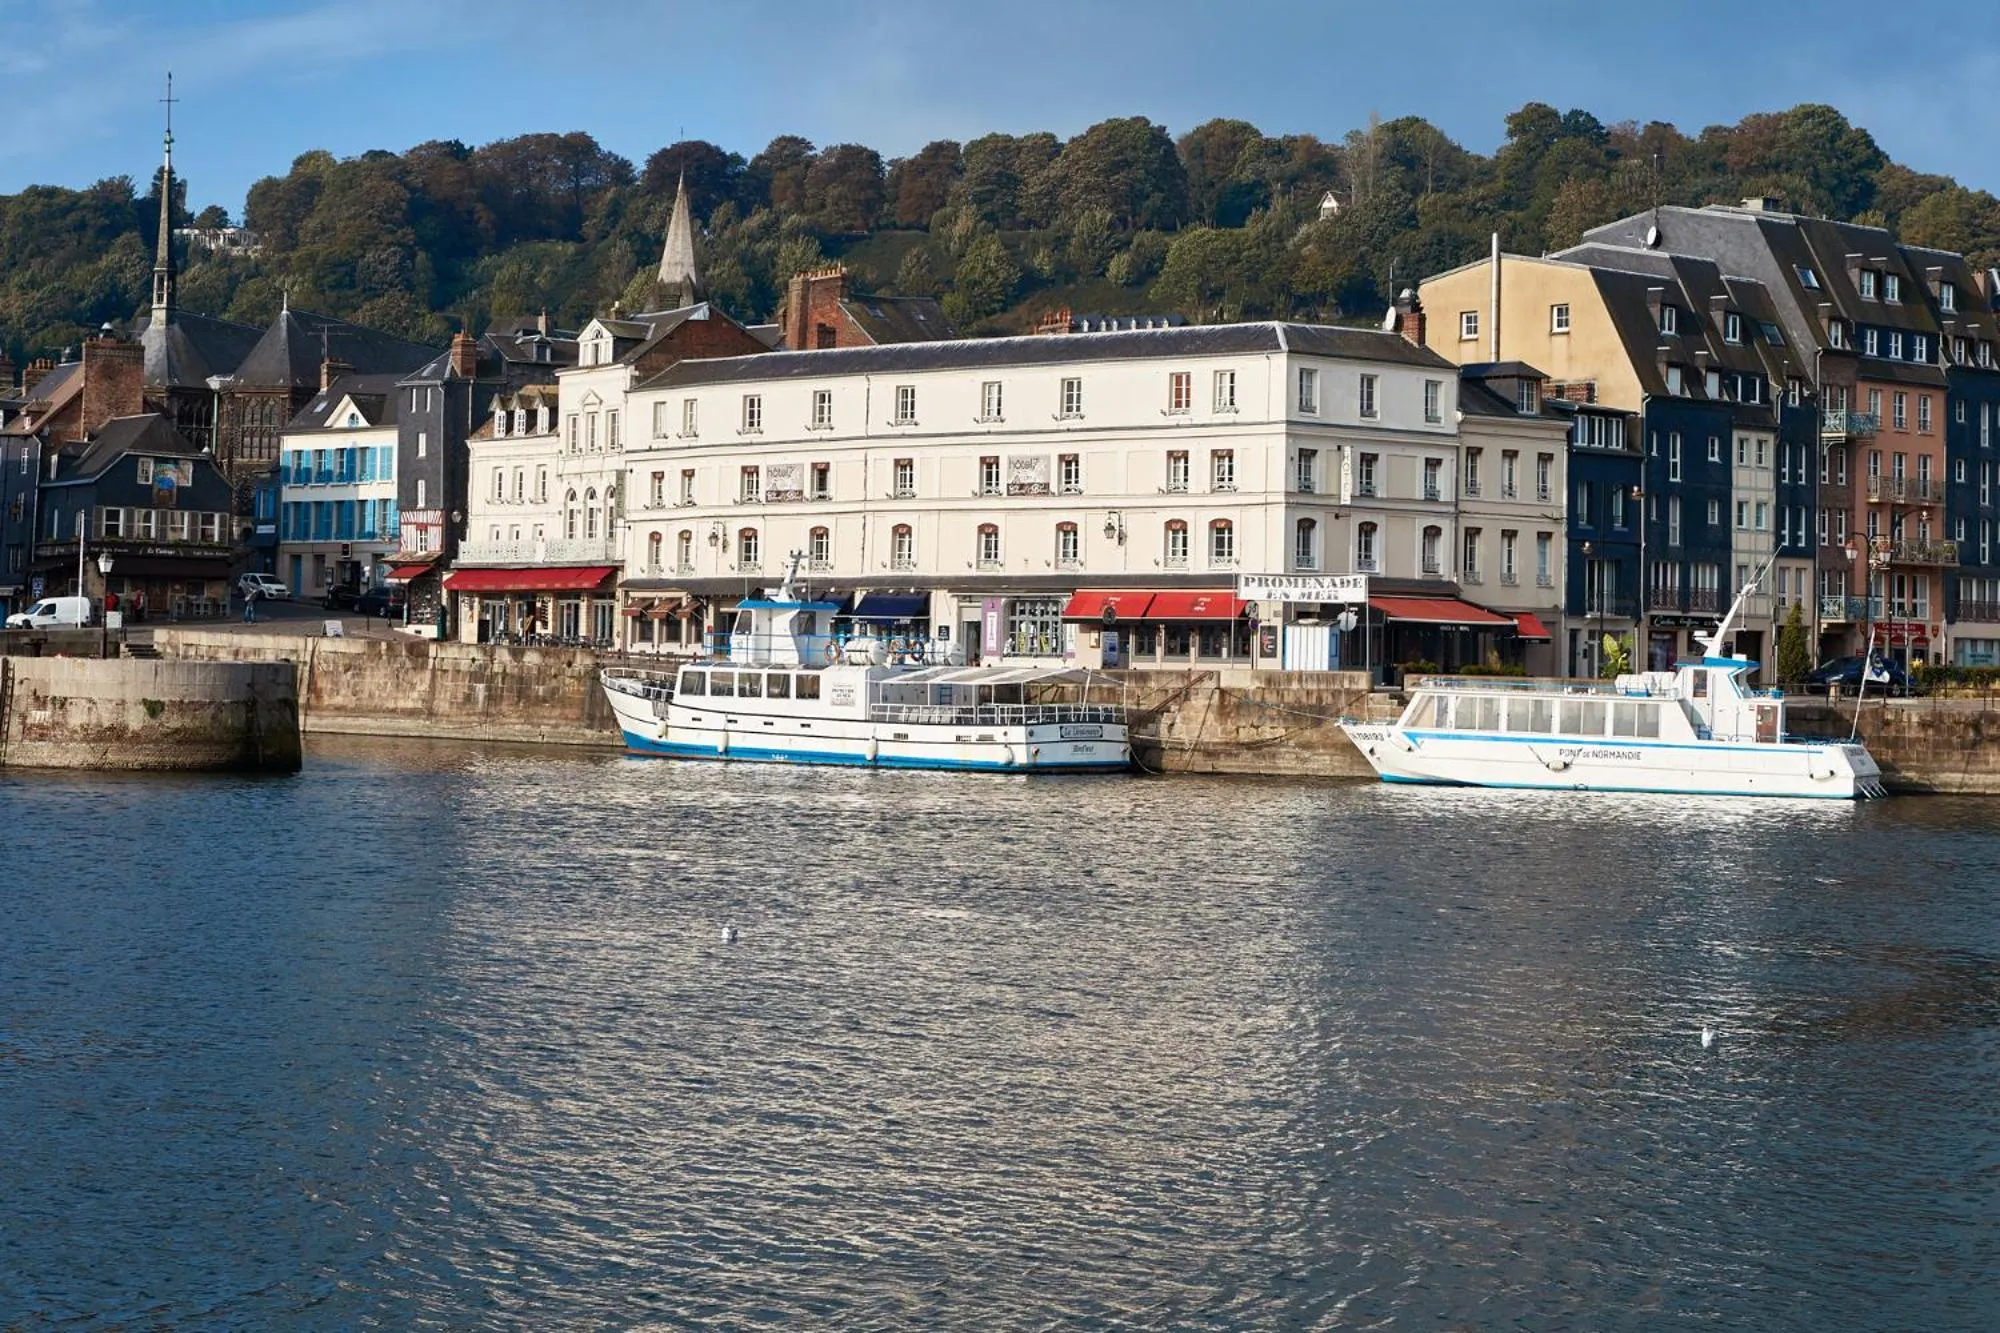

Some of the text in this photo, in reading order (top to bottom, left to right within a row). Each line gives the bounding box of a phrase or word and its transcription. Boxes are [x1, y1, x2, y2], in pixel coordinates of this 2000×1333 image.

[1243, 576, 1363, 588] PROMENADE
[1266, 589, 1339, 600] EN MER
[1559, 748, 1582, 757] PONT
[1592, 750, 1641, 760] NORMANDIE
